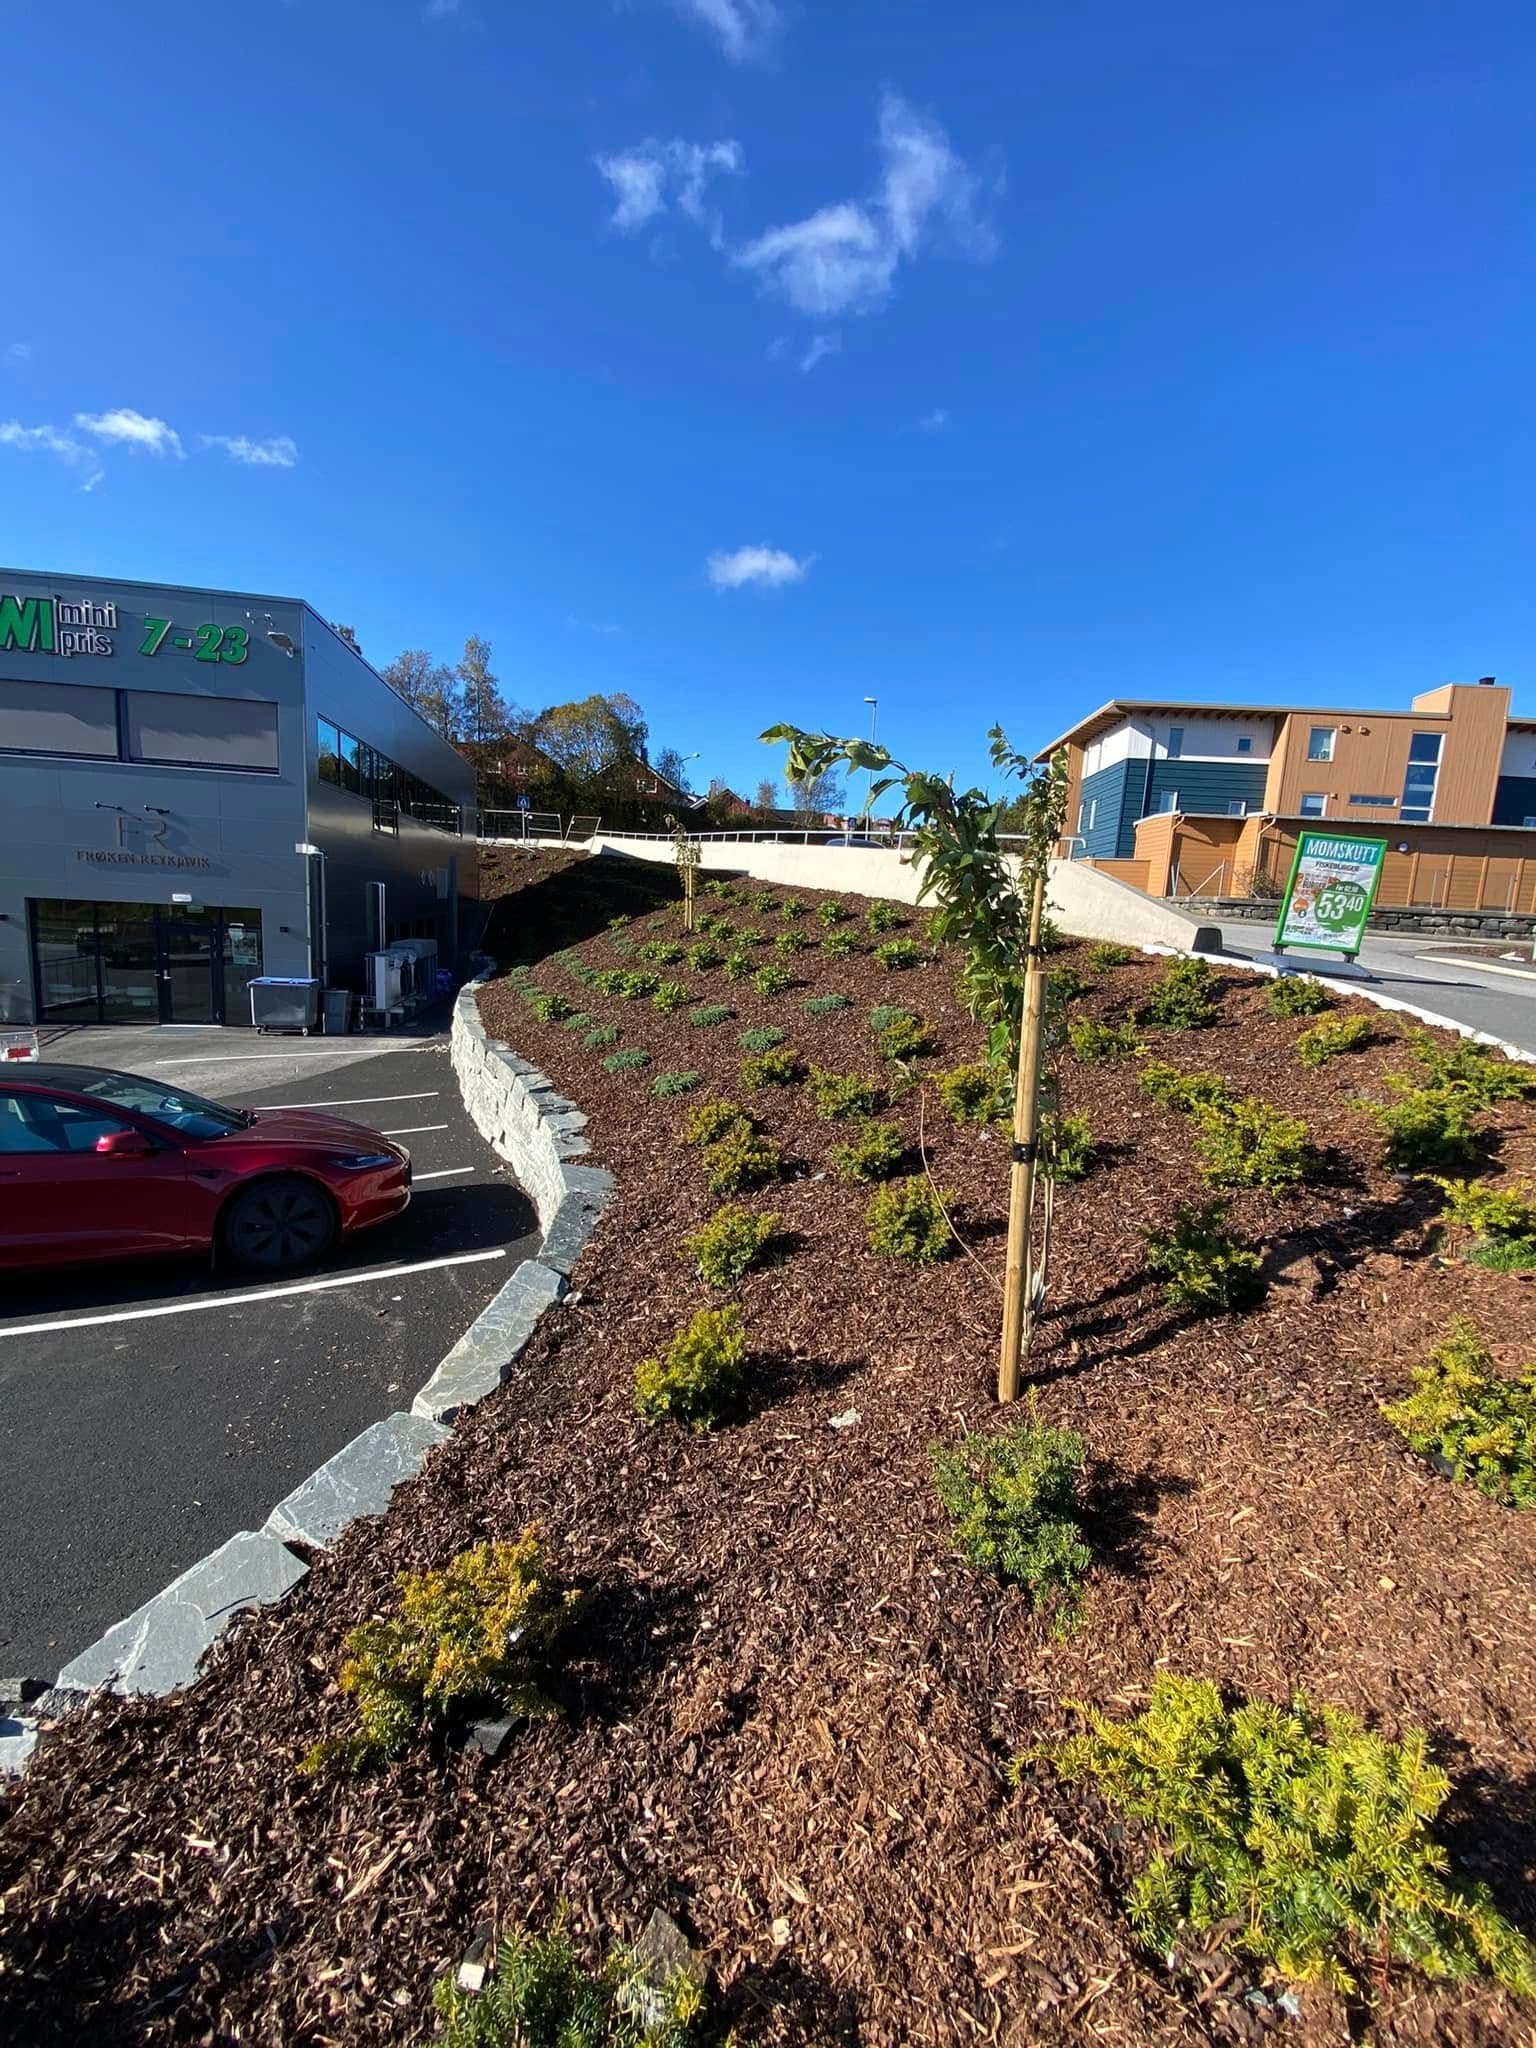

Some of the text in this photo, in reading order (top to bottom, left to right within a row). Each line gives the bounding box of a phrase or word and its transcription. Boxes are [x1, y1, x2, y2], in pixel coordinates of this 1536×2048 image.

[59, 599, 117, 628] mini
[60, 627, 113, 657] pris
[77, 849, 210, 870] FRØKEN REYKJAVIK
[1306, 839, 1378, 862] MOMSKUTT
